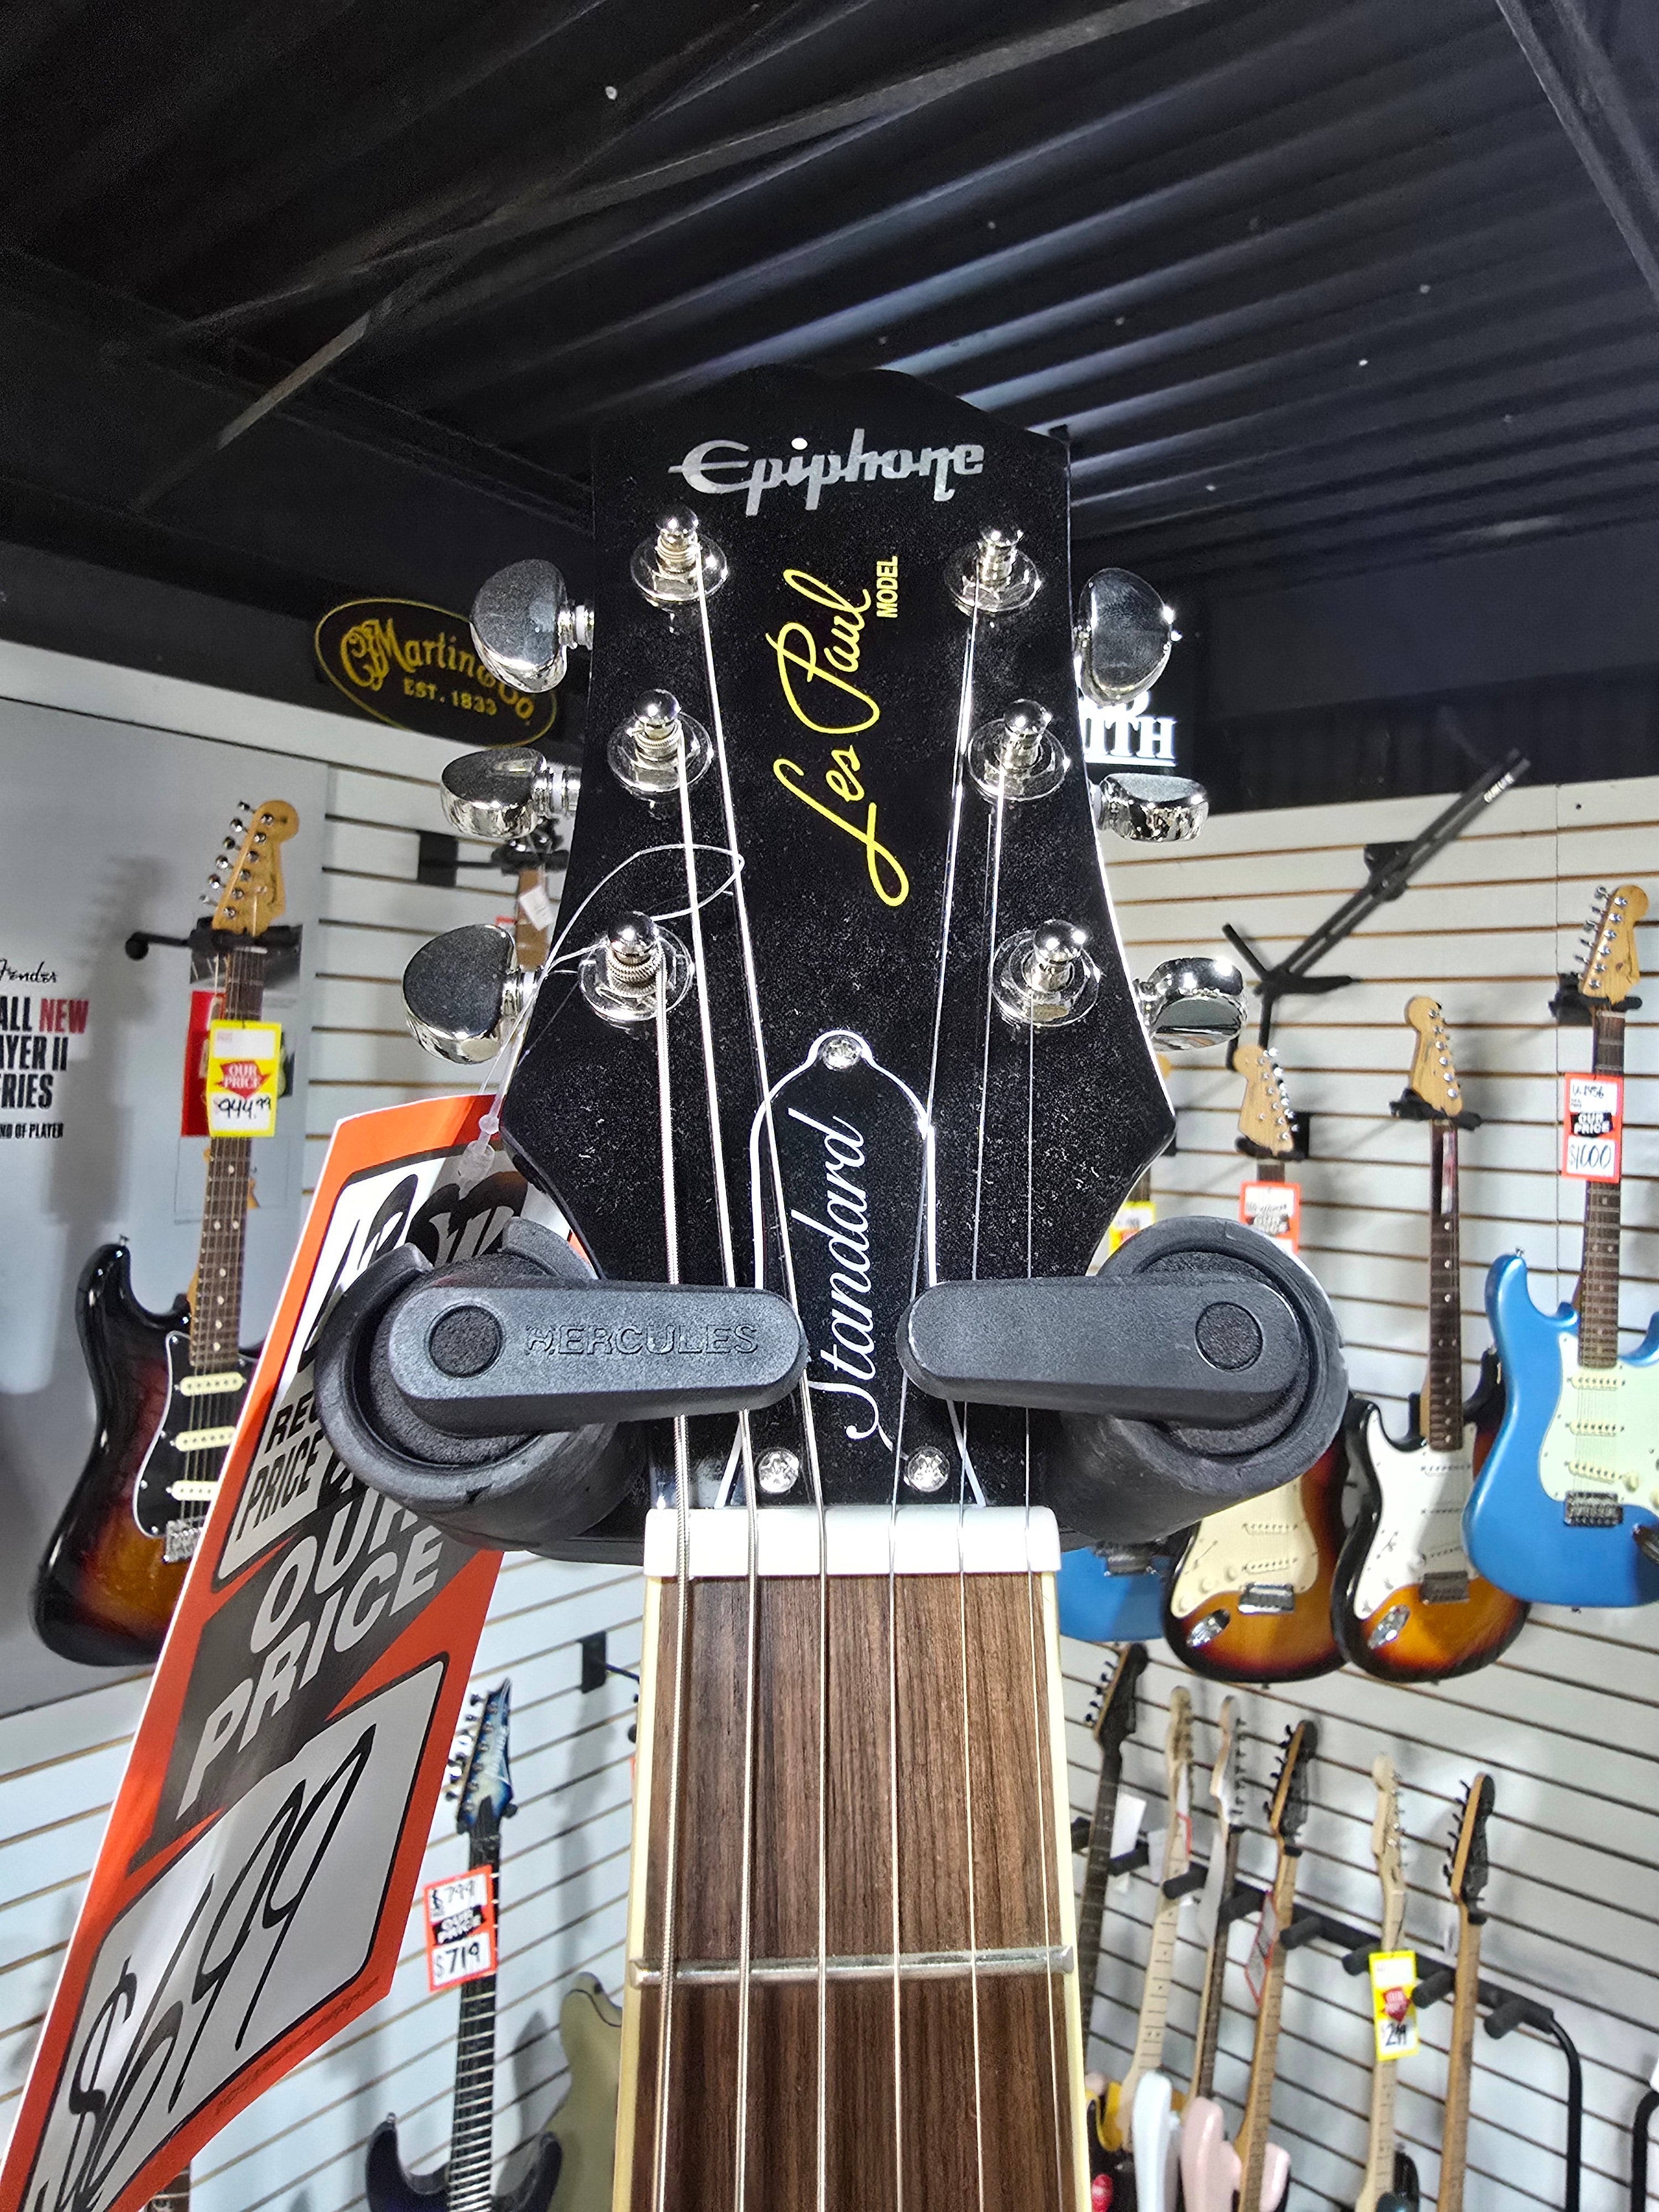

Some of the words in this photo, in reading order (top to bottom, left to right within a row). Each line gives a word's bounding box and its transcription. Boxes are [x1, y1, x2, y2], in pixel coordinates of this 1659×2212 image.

[667, 429, 984, 517] Epiphone
[876, 555, 899, 618] MODEL
[765, 569, 880, 734] Paul
[1079, 717, 1177, 759] ITH
[773, 745, 909, 907] Les
[39, 998, 90, 1034] NEW
[0, 1073, 54, 1109] RIES
[224, 1076, 261, 1089] PRICE
[228, 1063, 257, 1076] OUR
[787, 1107, 880, 1439] Standard
[525, 1324, 759, 1355] HERCULES
[237, 1428, 324, 1541] PRICE
[175, 1524, 442, 1822] PRICE
